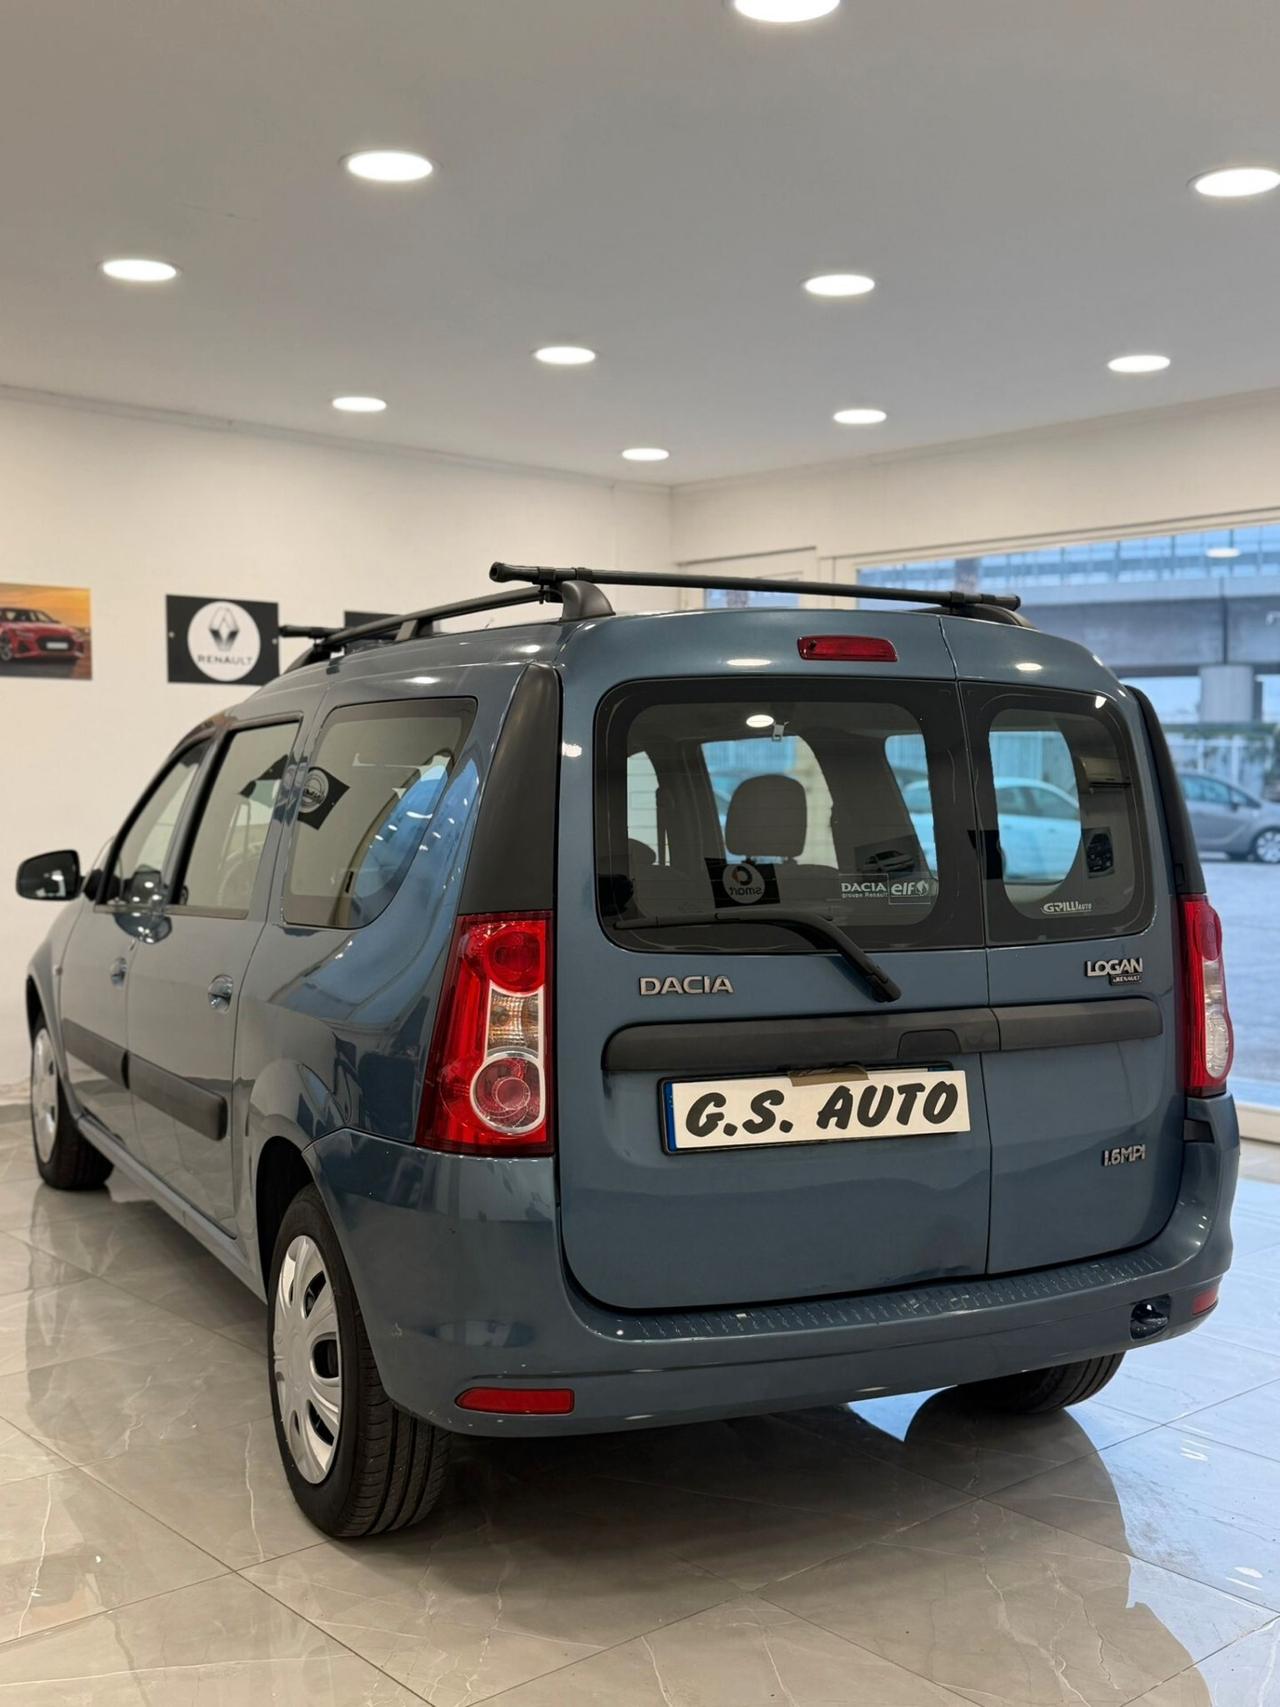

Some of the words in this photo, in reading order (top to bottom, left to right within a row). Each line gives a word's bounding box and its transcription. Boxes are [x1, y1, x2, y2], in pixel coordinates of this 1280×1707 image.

[197, 654, 252, 666] RENAULT
[841, 882, 887, 892] DACIA
[891, 881, 916, 895] elf
[1085, 958, 1143, 977] LOGAN
[640, 975, 734, 995] DACIA
[686, 1089, 794, 1137] G.S.
[816, 1080, 958, 1130] AUTO
